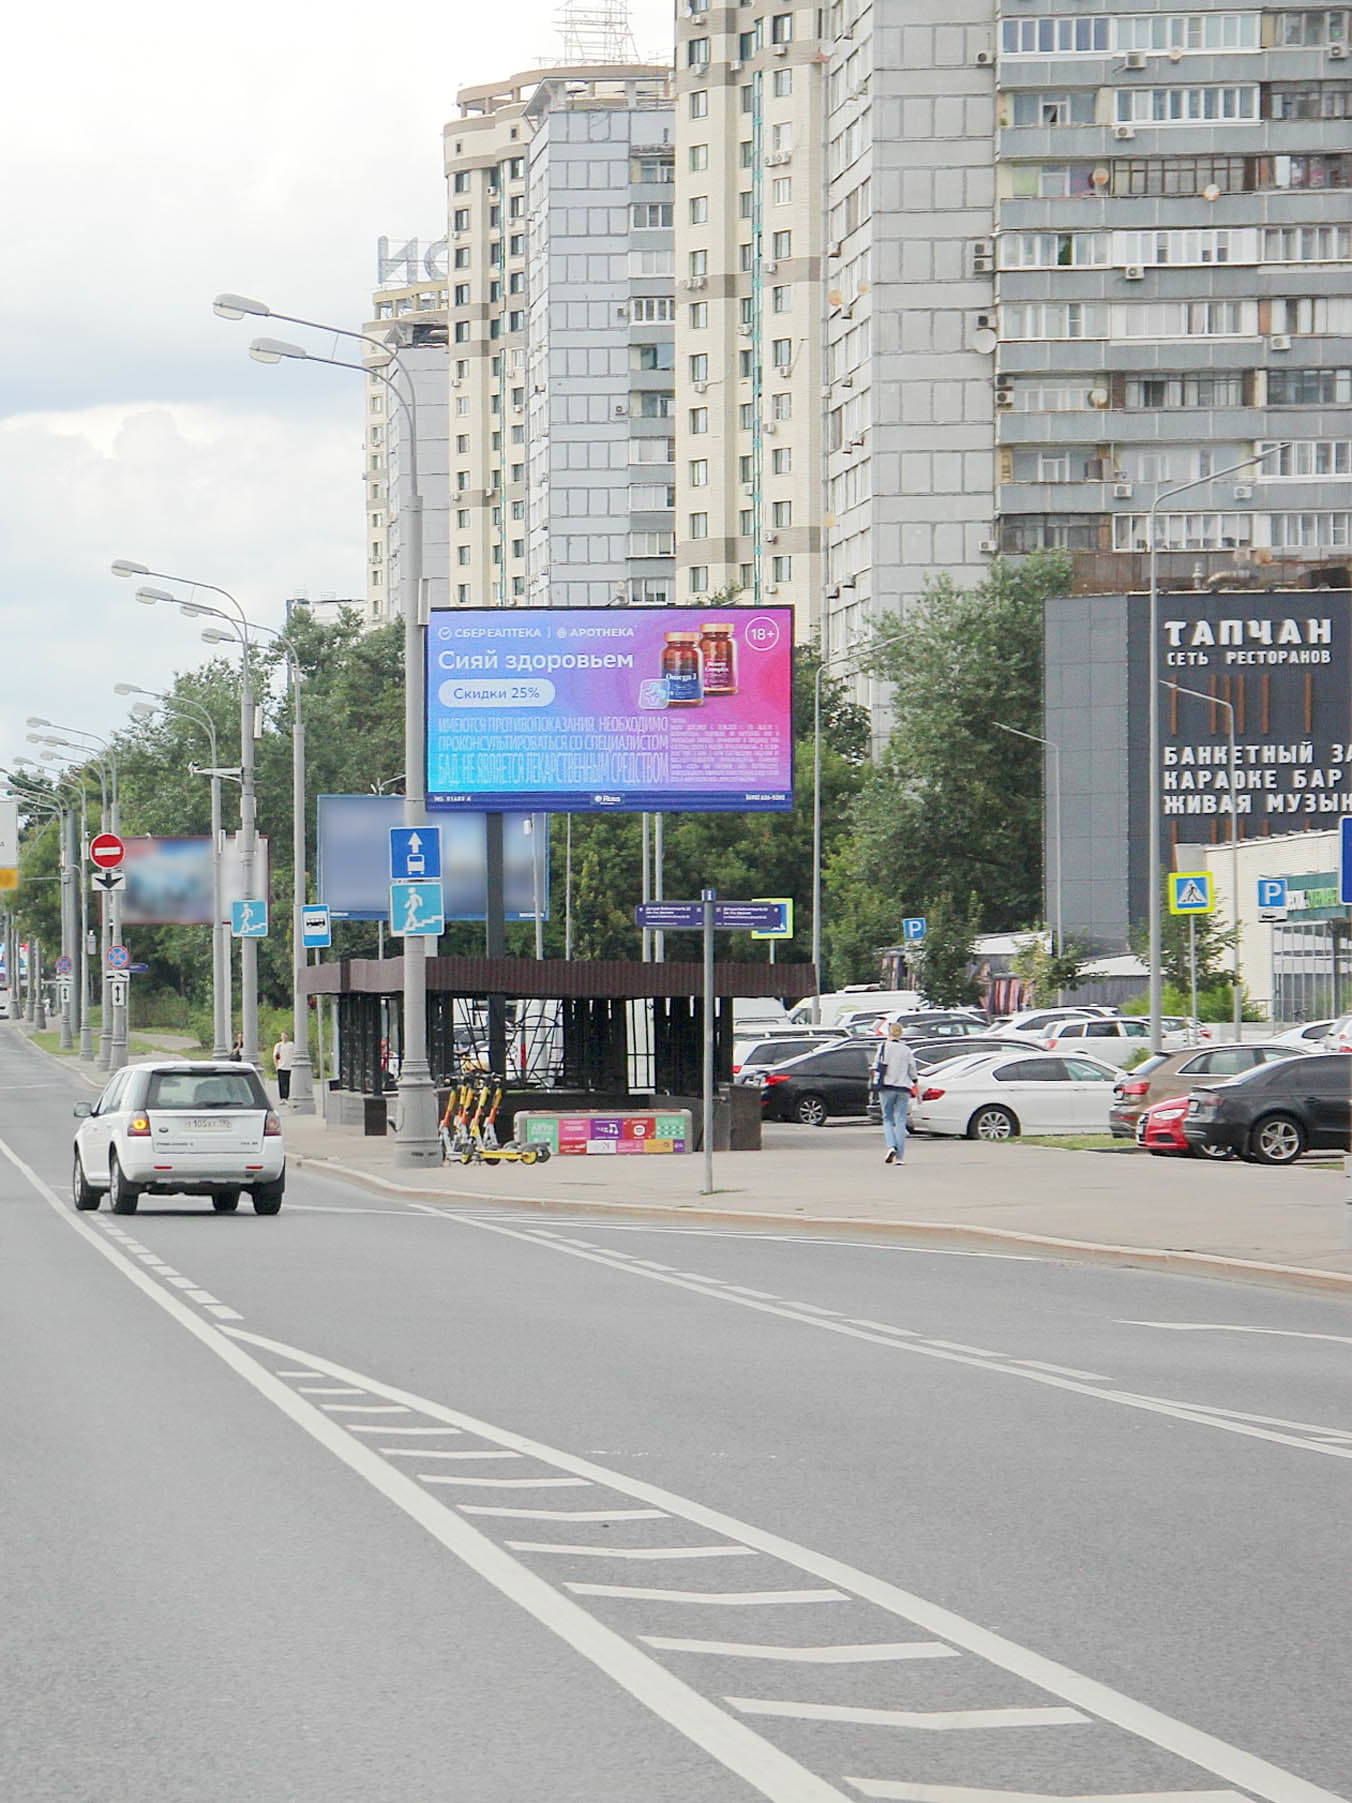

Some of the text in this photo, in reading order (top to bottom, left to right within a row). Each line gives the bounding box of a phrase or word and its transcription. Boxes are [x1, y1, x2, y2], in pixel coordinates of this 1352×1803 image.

[751, 628, 775, 641] 18+
[1164, 618, 1332, 647] ТАПЧАН
[438, 649, 633, 673] Сияй здоровьем
[1167, 650, 1332, 667] СЕТЬ РЕСТОРАНОВ
[453, 687, 540, 700] Скидки 25%
[599, 715, 668, 733] НЕОБХОДИМО
[438, 735, 568, 752] ПРОКОНСУЛЬТИРОВАТЬСЯ
[584, 733, 668, 752] СПЕЦИАЛИСТОМ
[1163, 741, 1314, 766] БАНКЕТНЫЙ
[1163, 769, 1342, 791] КАРАОКЕ БАР
[1163, 792, 1252, 815] ЖИВАЯ
